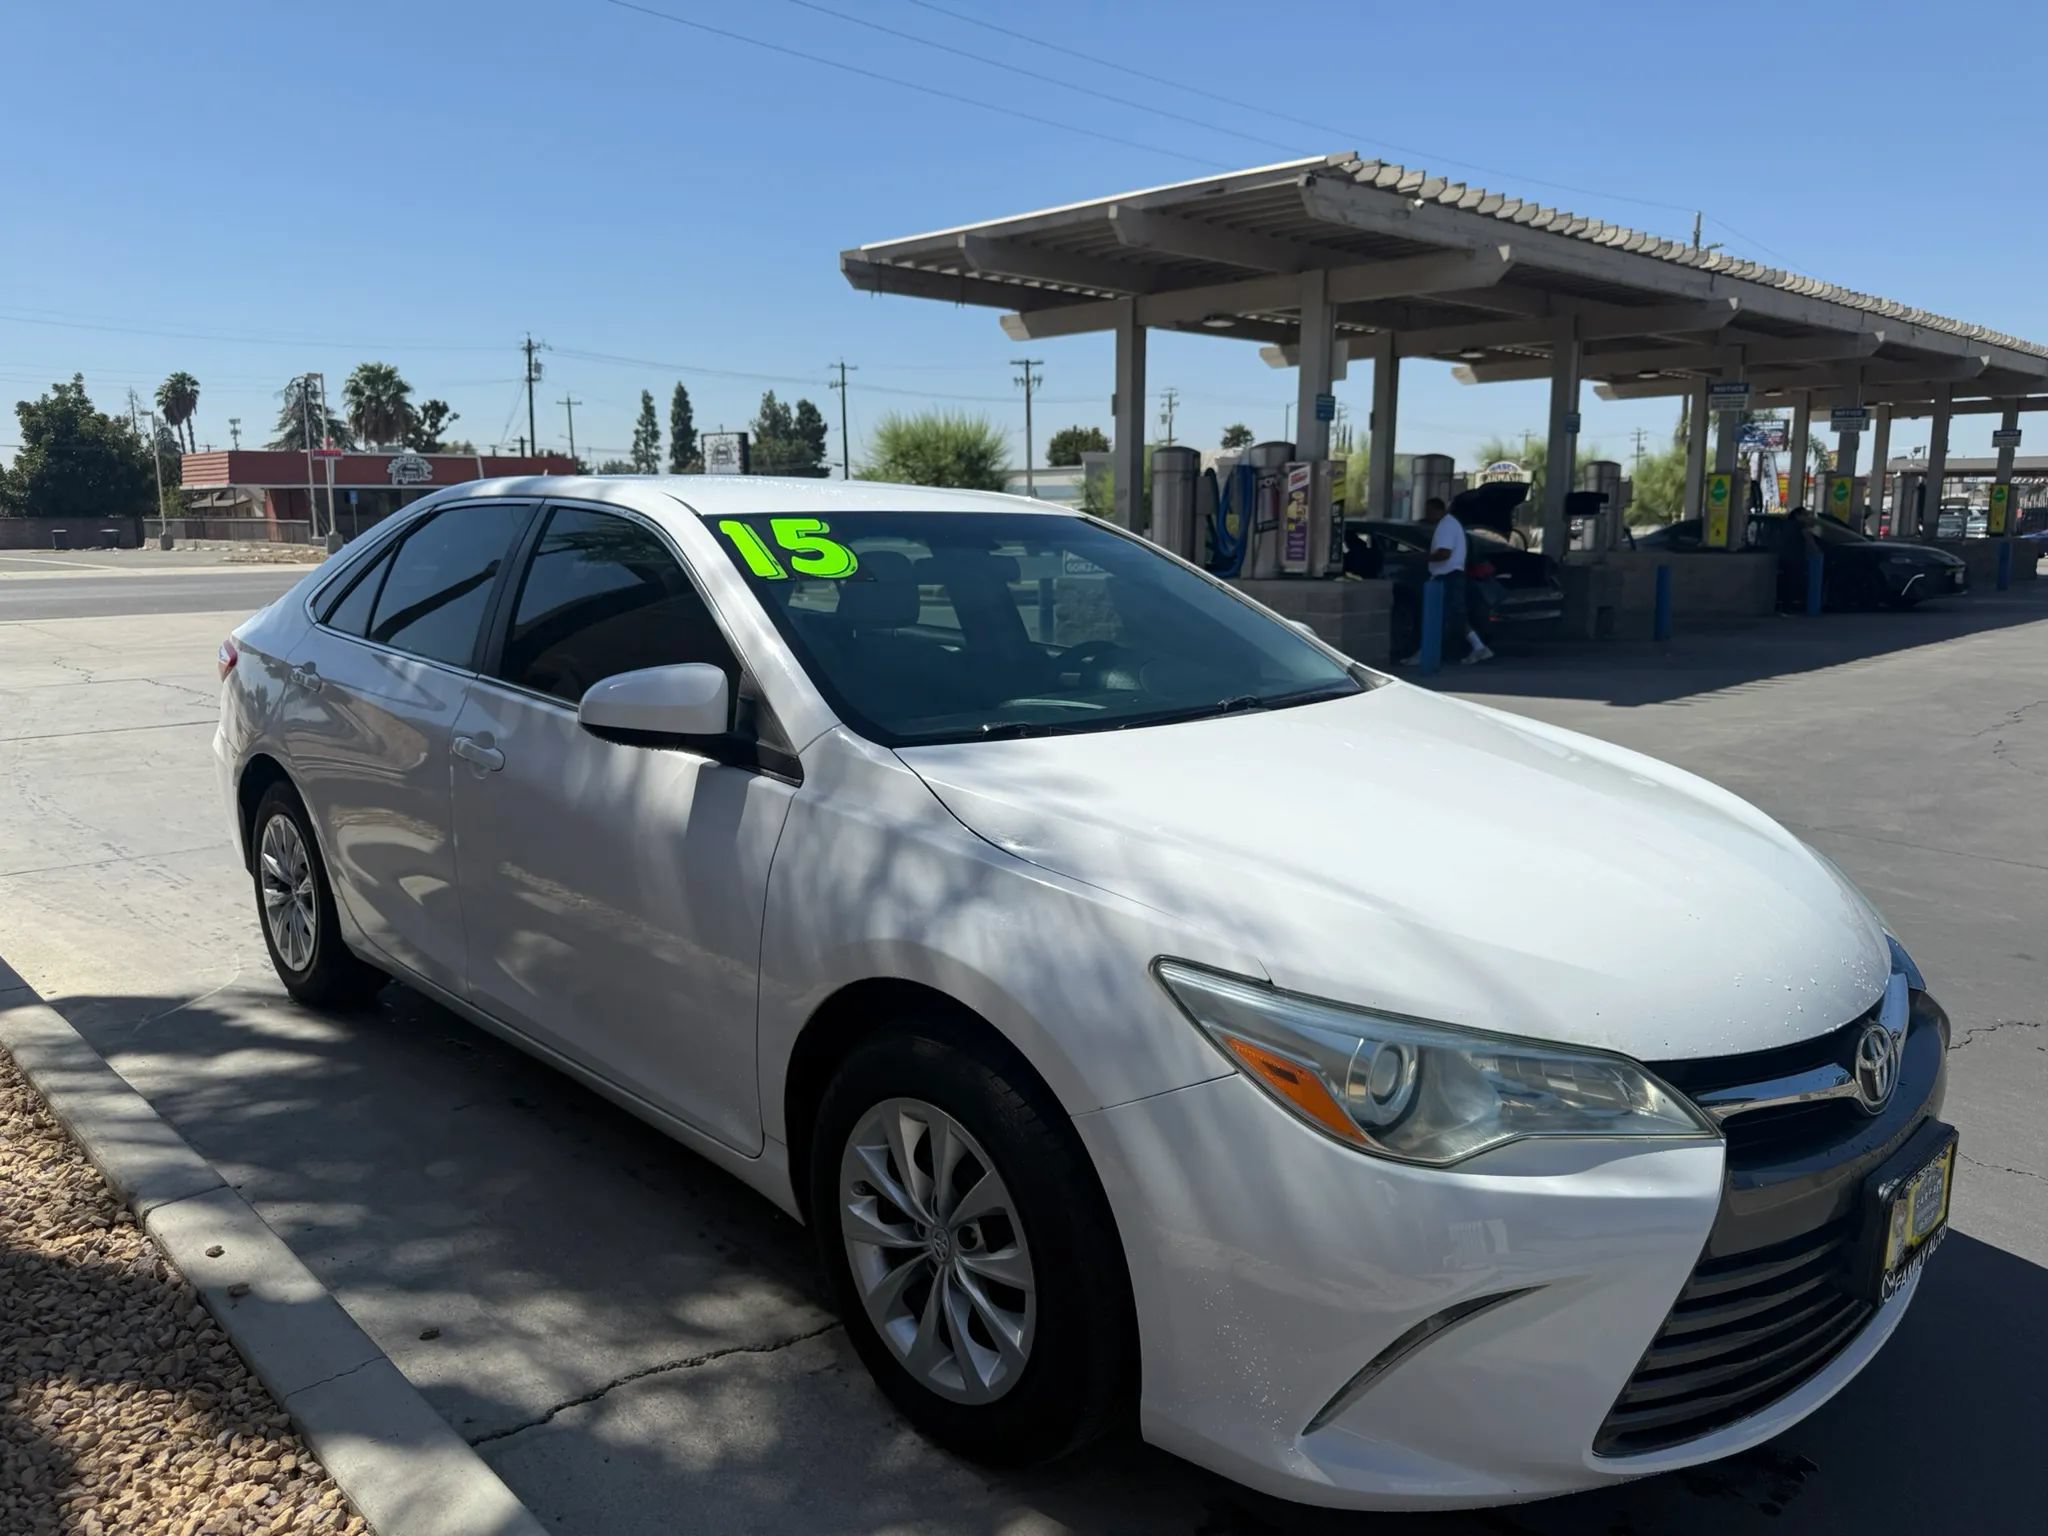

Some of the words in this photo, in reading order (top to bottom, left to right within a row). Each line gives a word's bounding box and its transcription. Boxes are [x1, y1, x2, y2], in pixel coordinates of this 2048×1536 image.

[718, 517, 859, 581] 15
[1894, 1248, 1927, 1292] FAMILY
[1927, 1222, 1947, 1260] AUTO
